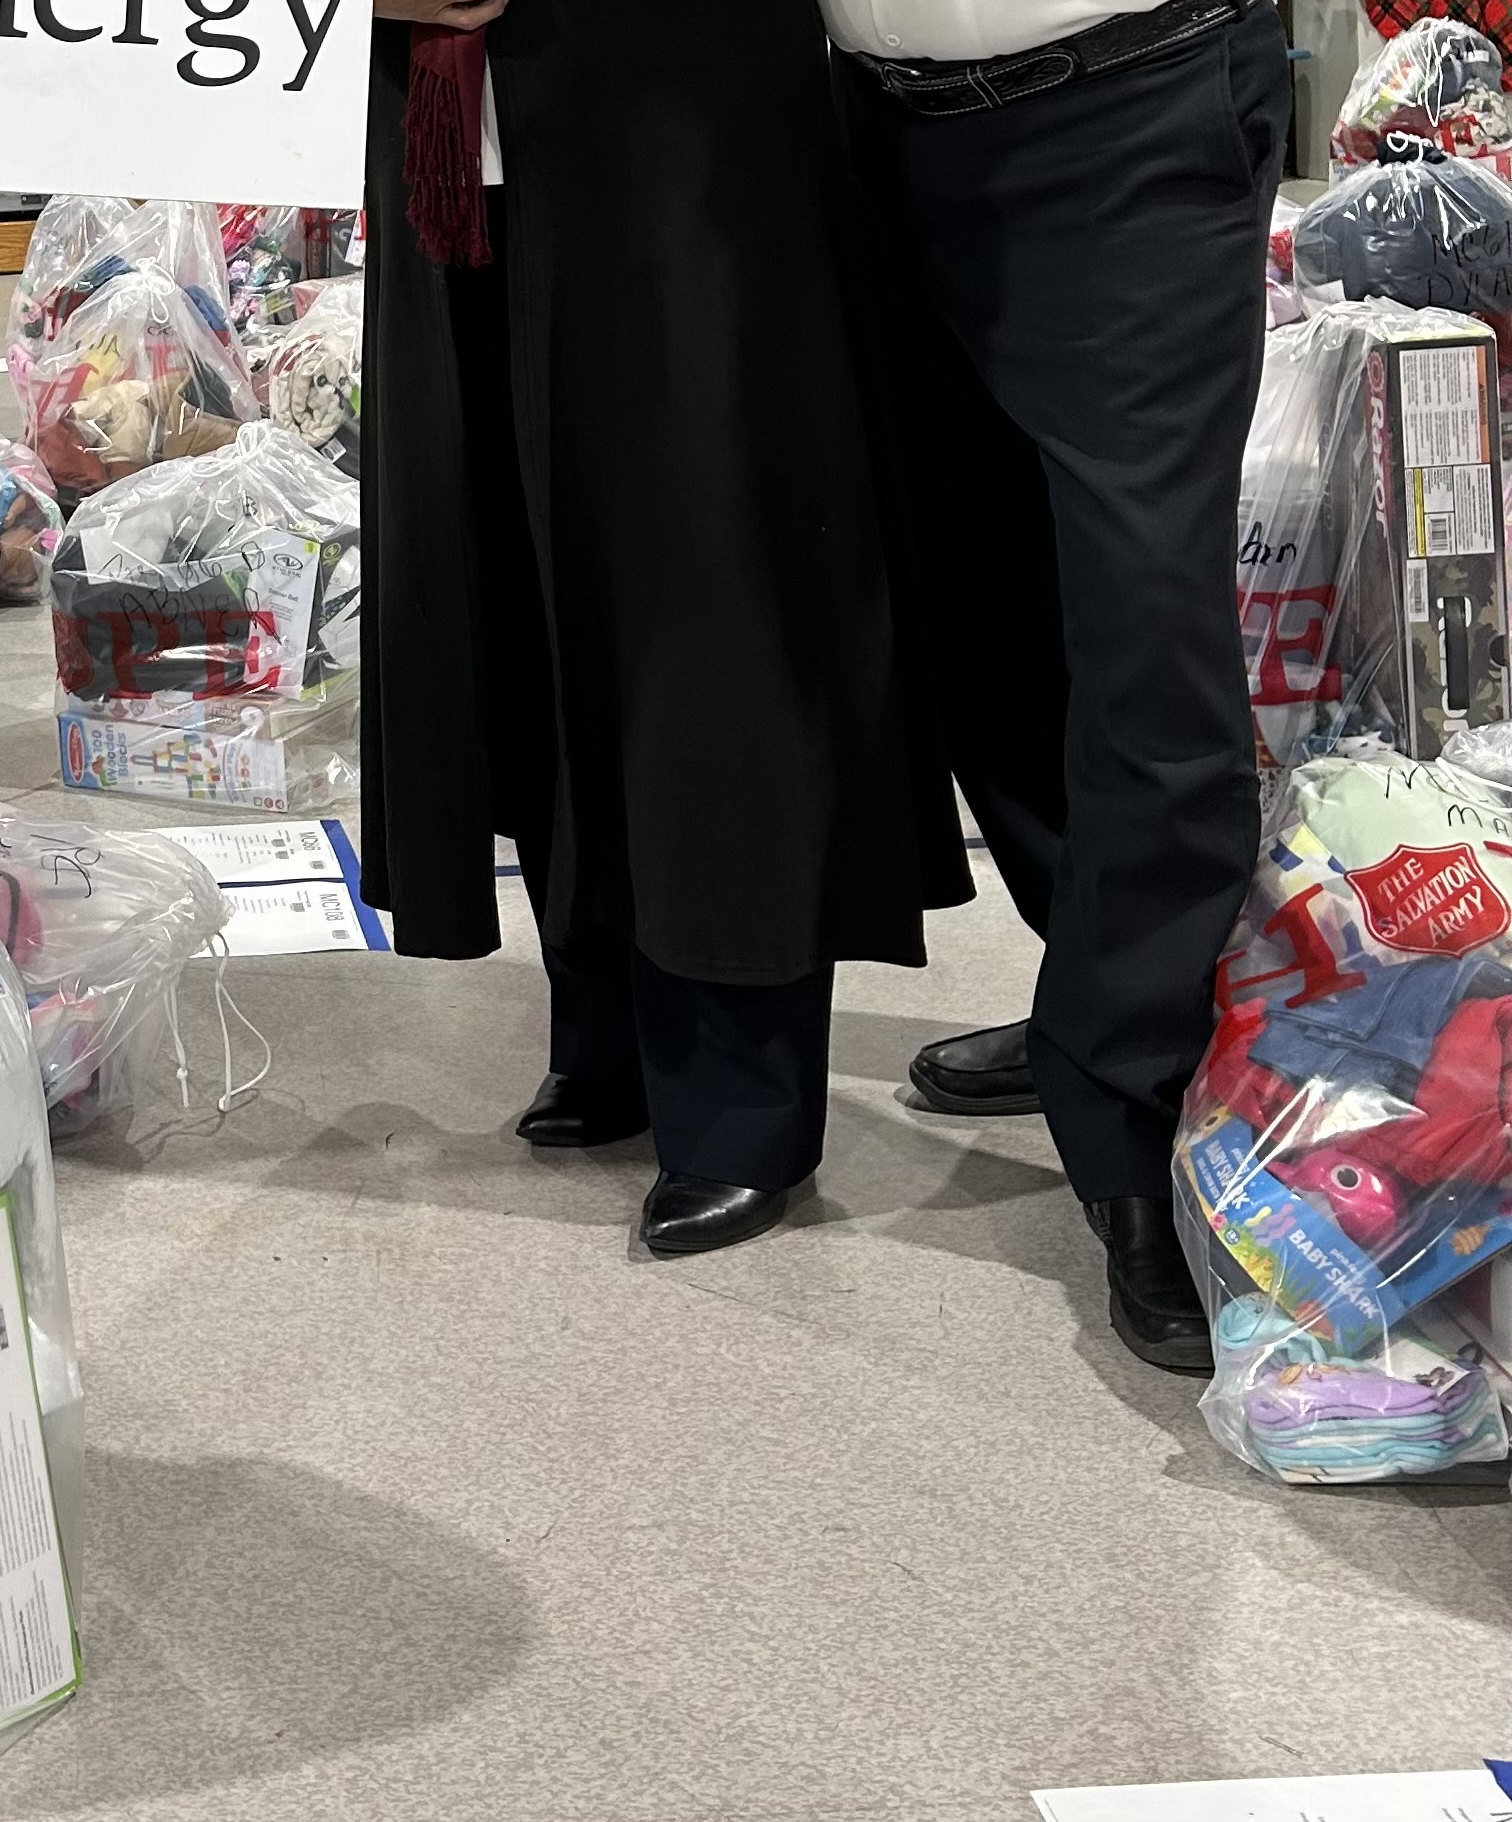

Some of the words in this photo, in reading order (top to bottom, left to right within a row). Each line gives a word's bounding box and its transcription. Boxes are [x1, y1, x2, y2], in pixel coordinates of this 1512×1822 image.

[1370, 396, 1388, 539] Razor
[105, 724, 115, 783] Wooden
[117, 732, 128, 777] Blocks
[1377, 855, 1477, 938] SALVATION
[1378, 857, 1424, 904] THE
[1427, 885, 1484, 948] ARMY
[1216, 1162, 1251, 1211] SHAK
[1289, 1228, 1333, 1270] BABY
[1325, 1267, 1381, 1320] SHARK
